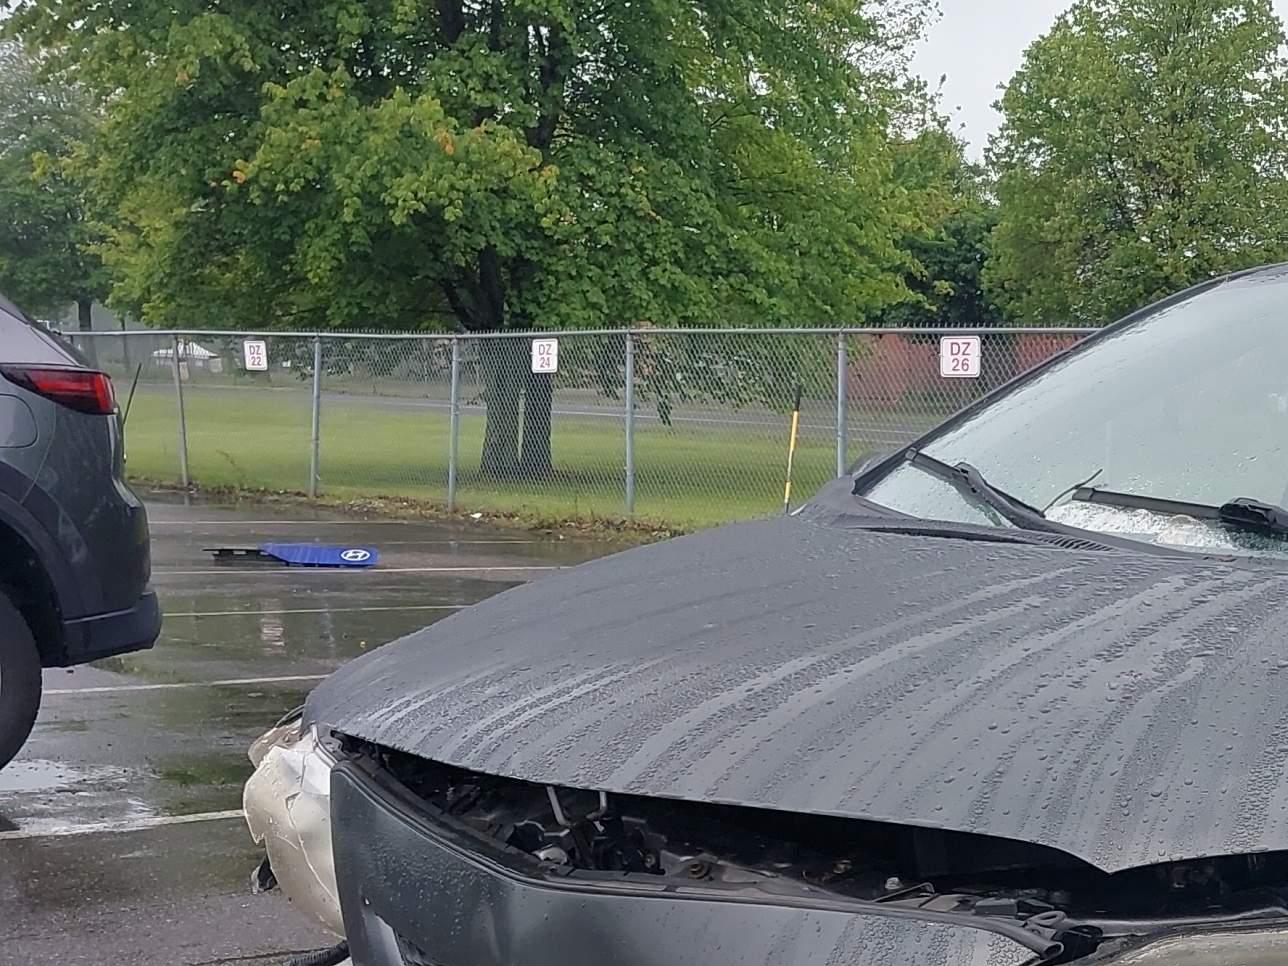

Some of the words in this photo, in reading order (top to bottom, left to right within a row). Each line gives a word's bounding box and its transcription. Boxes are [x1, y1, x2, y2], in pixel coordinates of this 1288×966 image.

[249, 345, 261, 355] DZ
[539, 344, 552, 355] DZ
[951, 342, 971, 356] DZ
[251, 356, 262, 366] 22
[540, 357, 550, 368] 24
[952, 358, 969, 371] 26
